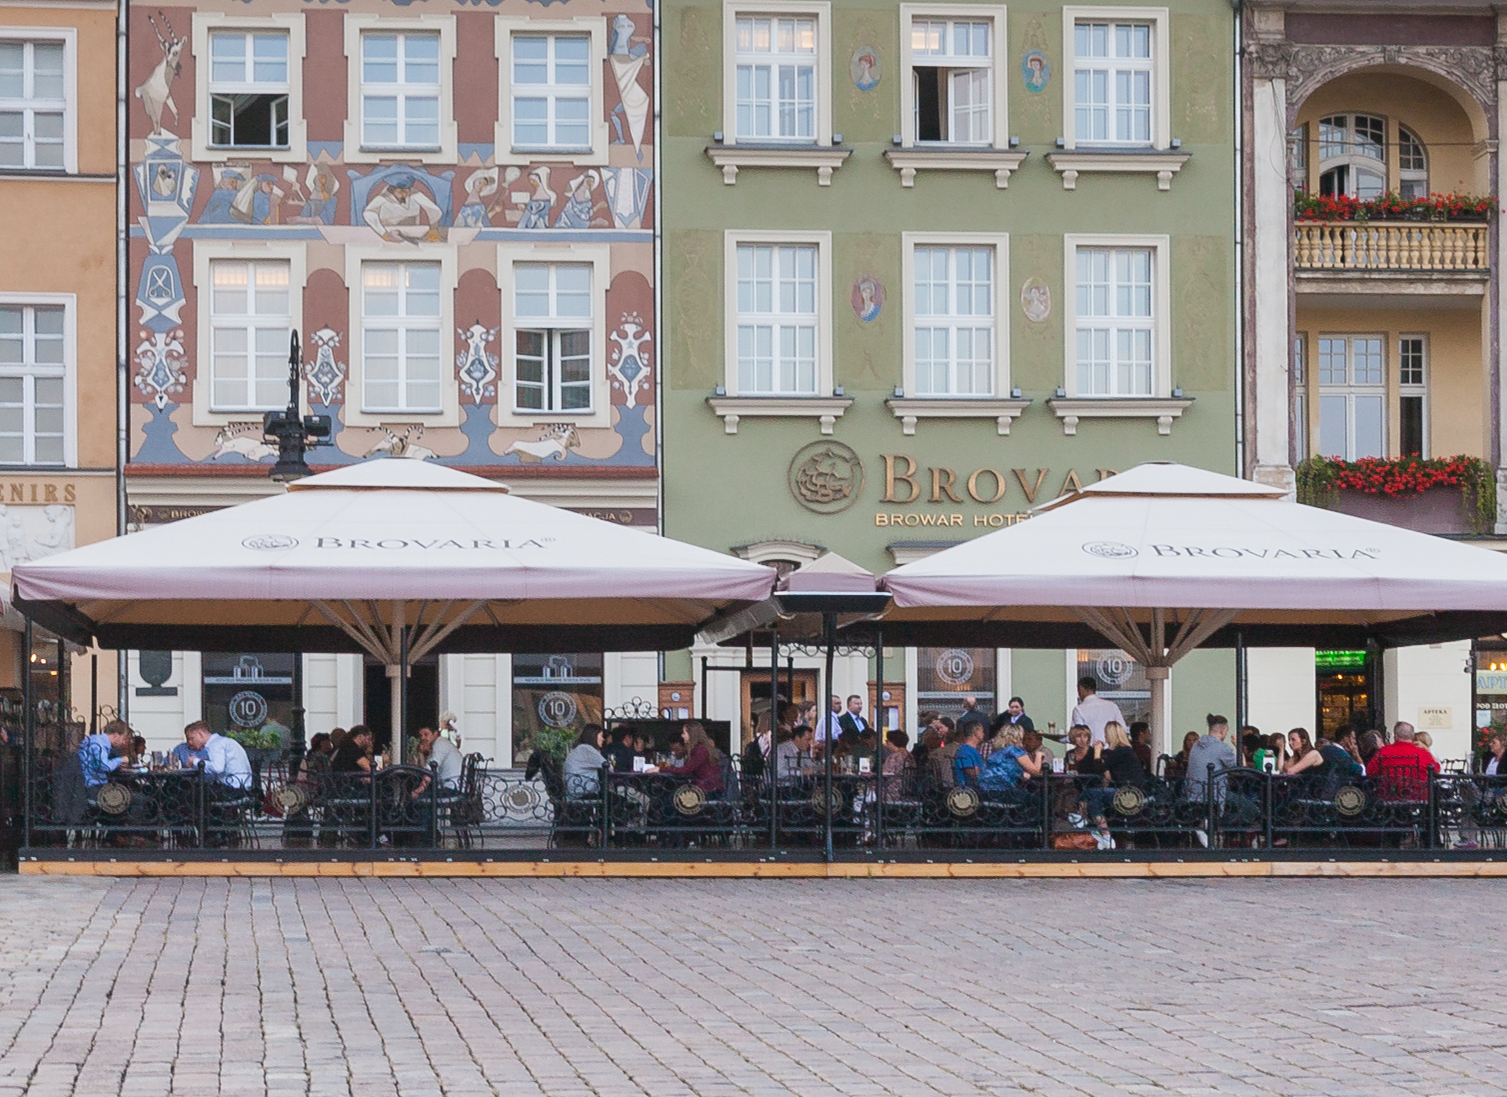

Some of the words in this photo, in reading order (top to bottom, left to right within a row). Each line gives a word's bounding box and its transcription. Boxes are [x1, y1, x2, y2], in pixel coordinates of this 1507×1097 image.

[878, 453, 1121, 503] BROVA
[874, 513, 964, 527] BROWAR
[973, 513, 1035, 527] HOTE
[946, 658, 963, 674] 10
[1107, 658, 1123, 674] 10
[240, 700, 256, 716] 10
[549, 700, 566, 716] 10
[1476, 702, 1491, 710] POD
